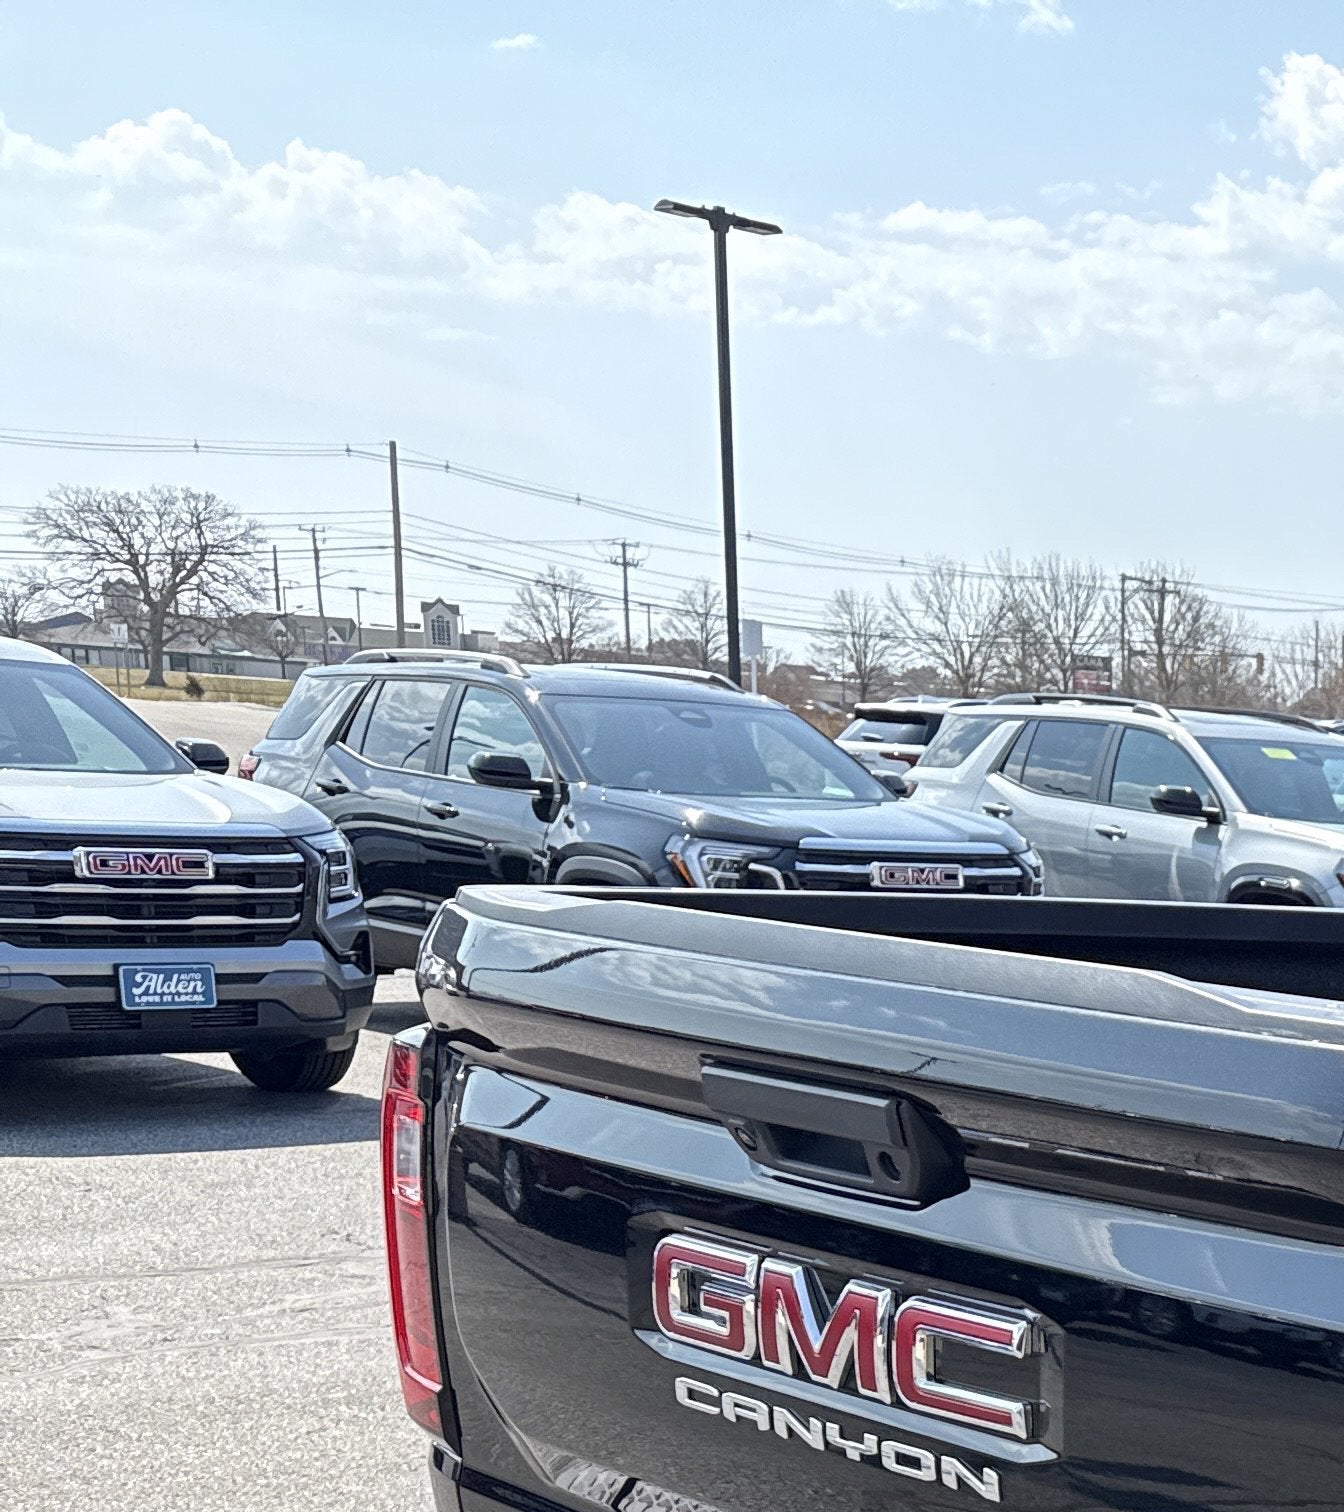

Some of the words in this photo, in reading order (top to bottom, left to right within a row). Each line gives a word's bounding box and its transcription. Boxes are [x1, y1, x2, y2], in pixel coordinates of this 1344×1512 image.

[88, 852, 209, 876] GMC
[880, 866, 960, 886] GMC
[132, 972, 205, 995] Alden
[180, 972, 202, 981] AUTO
[135, 995, 161, 1003] LOVE
[174, 994, 206, 1002] LOCAL
[652, 1233, 1031, 1441] GMC
[674, 1376, 1002, 1503] CANYON
